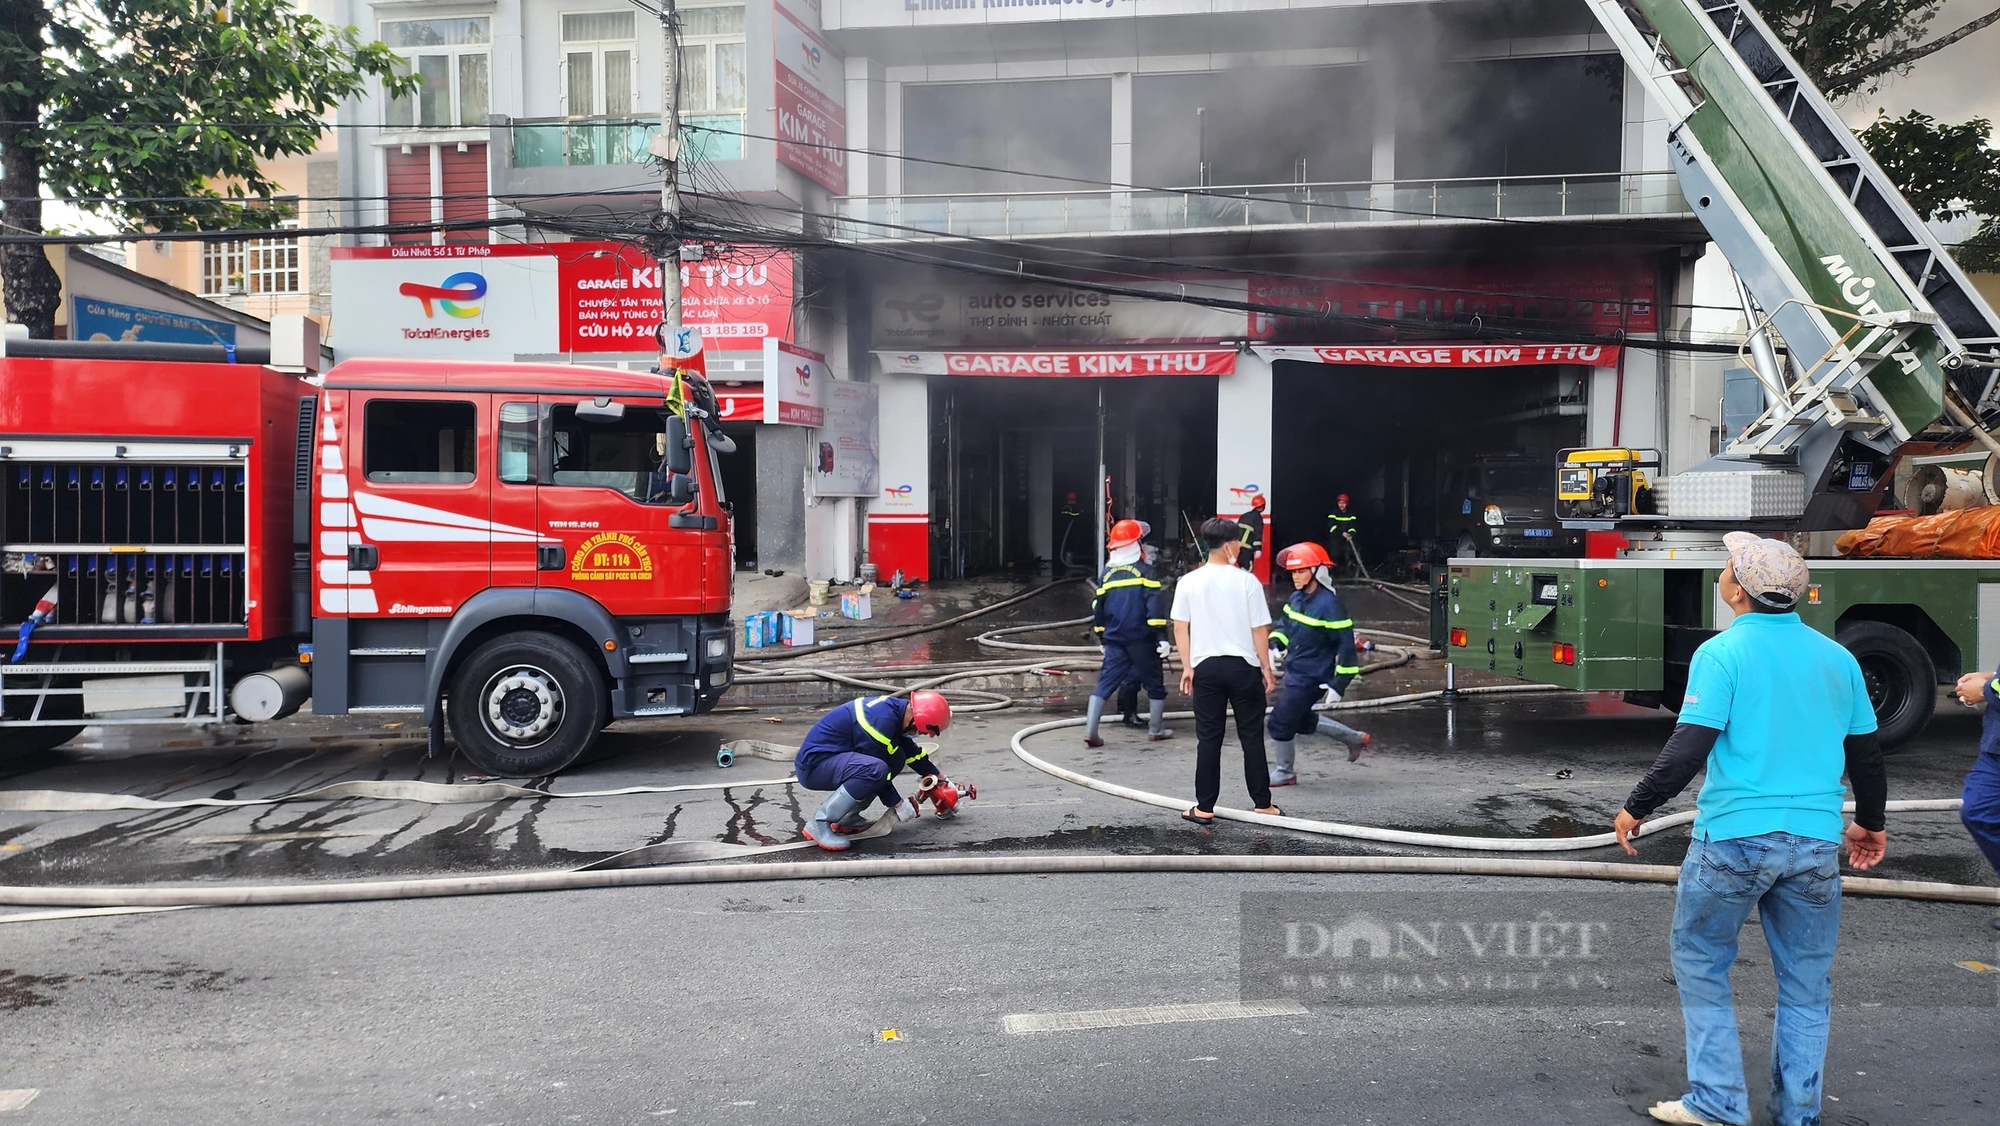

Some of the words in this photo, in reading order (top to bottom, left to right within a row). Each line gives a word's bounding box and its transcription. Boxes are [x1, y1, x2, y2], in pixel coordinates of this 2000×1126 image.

[797, 103, 826, 132] GARAGE
[779, 107, 808, 147] KIM
[447, 248, 453, 256] 1
[468, 246, 491, 257] Pháp
[577, 279, 629, 290] GARAGE
[699, 264, 768, 288] THU
[620, 297, 639, 307] TÂN
[681, 296, 700, 307] SỬA
[732, 297, 745, 305] XE
[747, 295, 755, 305] Ô
[757, 294, 770, 305] TÔ
[968, 292, 1016, 309] auto
[1022, 291, 1111, 308] services
[578, 310, 598, 320] BÁN
[600, 311, 620, 321] PHỤ
[622, 309, 648, 319] TÙNG
[650, 309, 658, 319] Ô
[682, 309, 695, 318] ÁC
[969, 314, 994, 329] THỢ
[1042, 312, 1077, 326] NHỚT
[1080, 310, 1112, 326] CHẤT
[401, 328, 490, 341] TotalEnergies
[579, 322, 609, 337] CỨU
[611, 322, 633, 339] HỘ
[716, 325, 738, 335] 185
[742, 325, 764, 335] 185
[950, 354, 1070, 374] GARAGE
[1079, 354, 1132, 373] KIM
[1141, 353, 1207, 372] THU
[1318, 348, 1452, 364] GARAGE
[1462, 349, 1520, 364] KIM
[1536, 346, 1601, 361] THU
[571, 550, 586, 571] CÔNG
[581, 541, 594, 552] AN
[591, 531, 618, 544] THÀNH
[618, 532, 637, 545] PHỐ
[594, 553, 611, 566] ĐT:
[612, 553, 631, 566] 114
[630, 571, 638, 580] VÀ
[388, 603, 453, 615] Schlingmann
